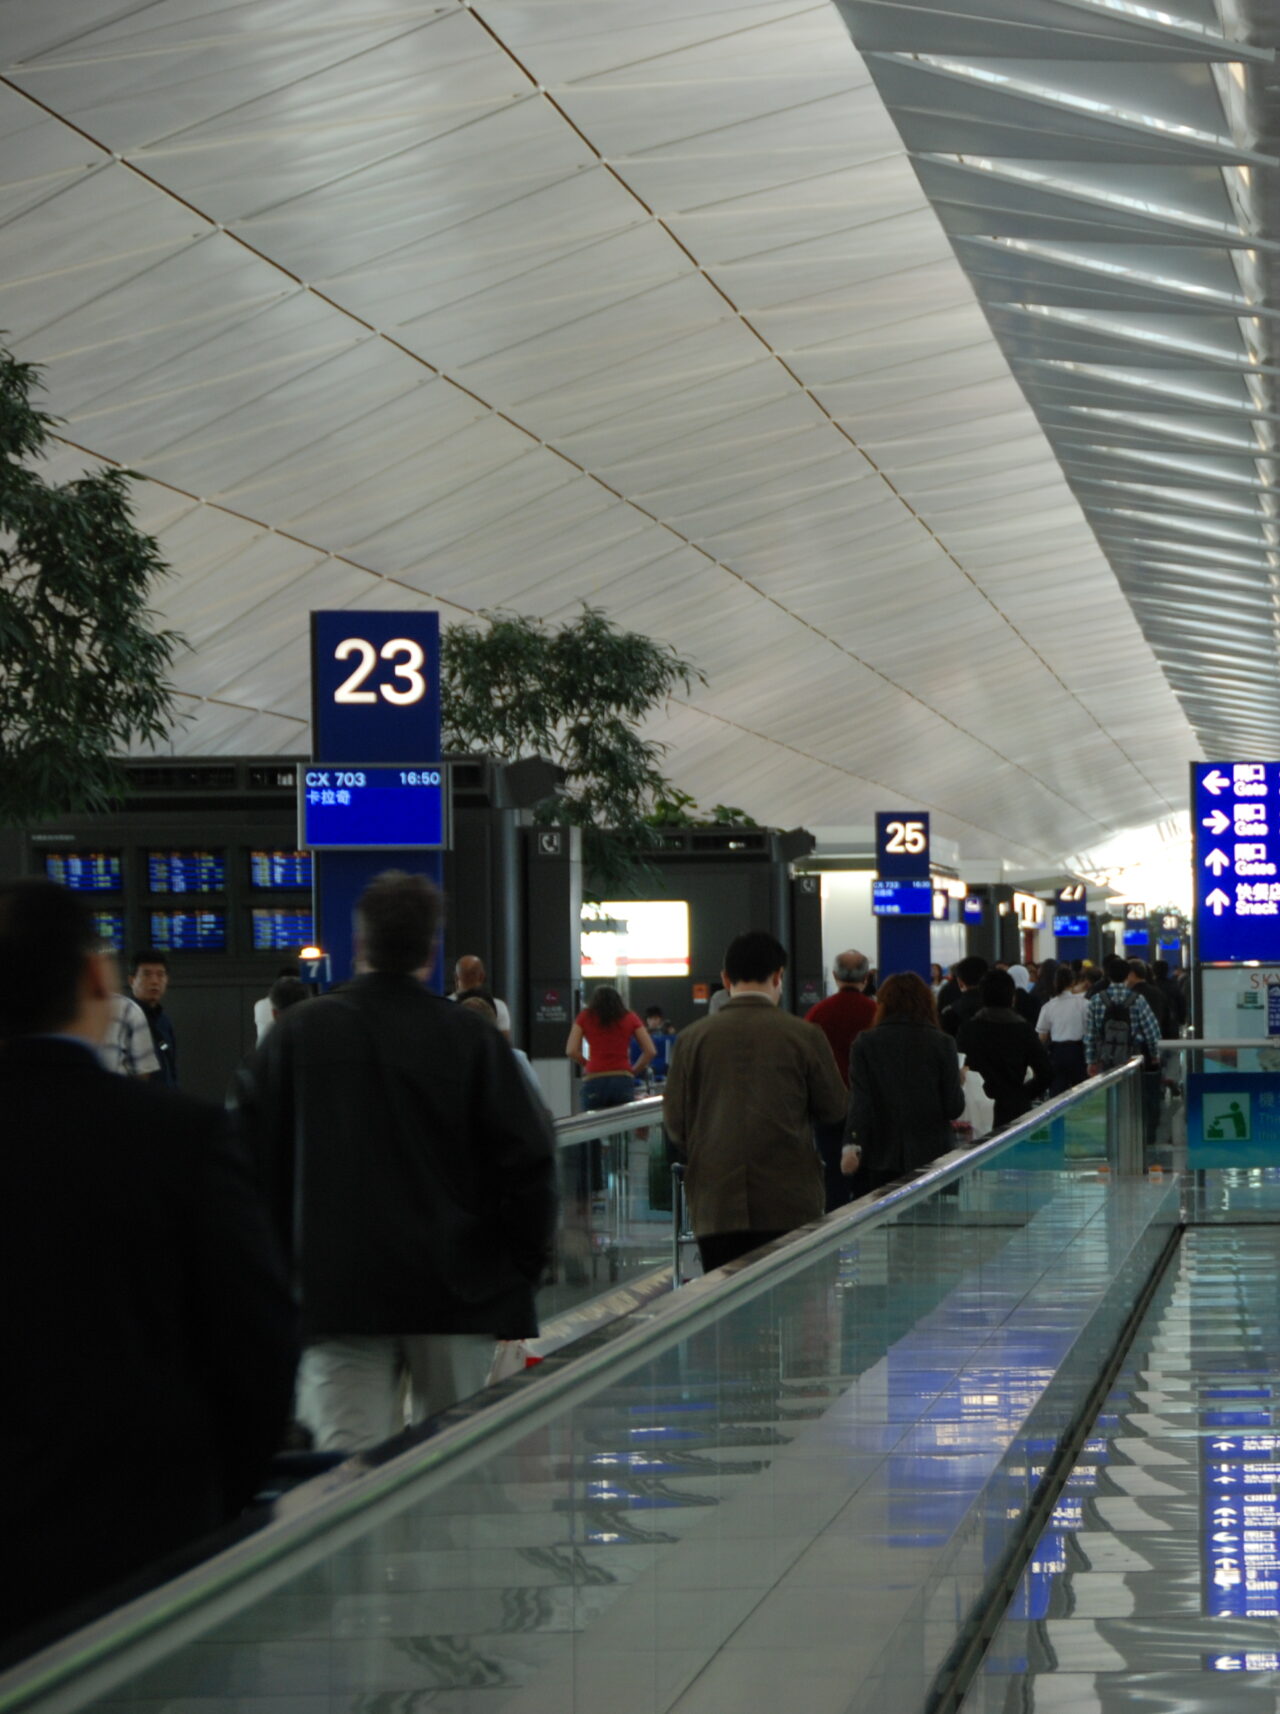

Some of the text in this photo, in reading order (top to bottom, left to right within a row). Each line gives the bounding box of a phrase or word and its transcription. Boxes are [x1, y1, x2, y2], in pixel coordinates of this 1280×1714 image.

[334, 637, 427, 706] 23
[306, 771, 441, 787] CX 703 16:50
[885, 821, 926, 854] 25
[1127, 904, 1144, 920] 29
